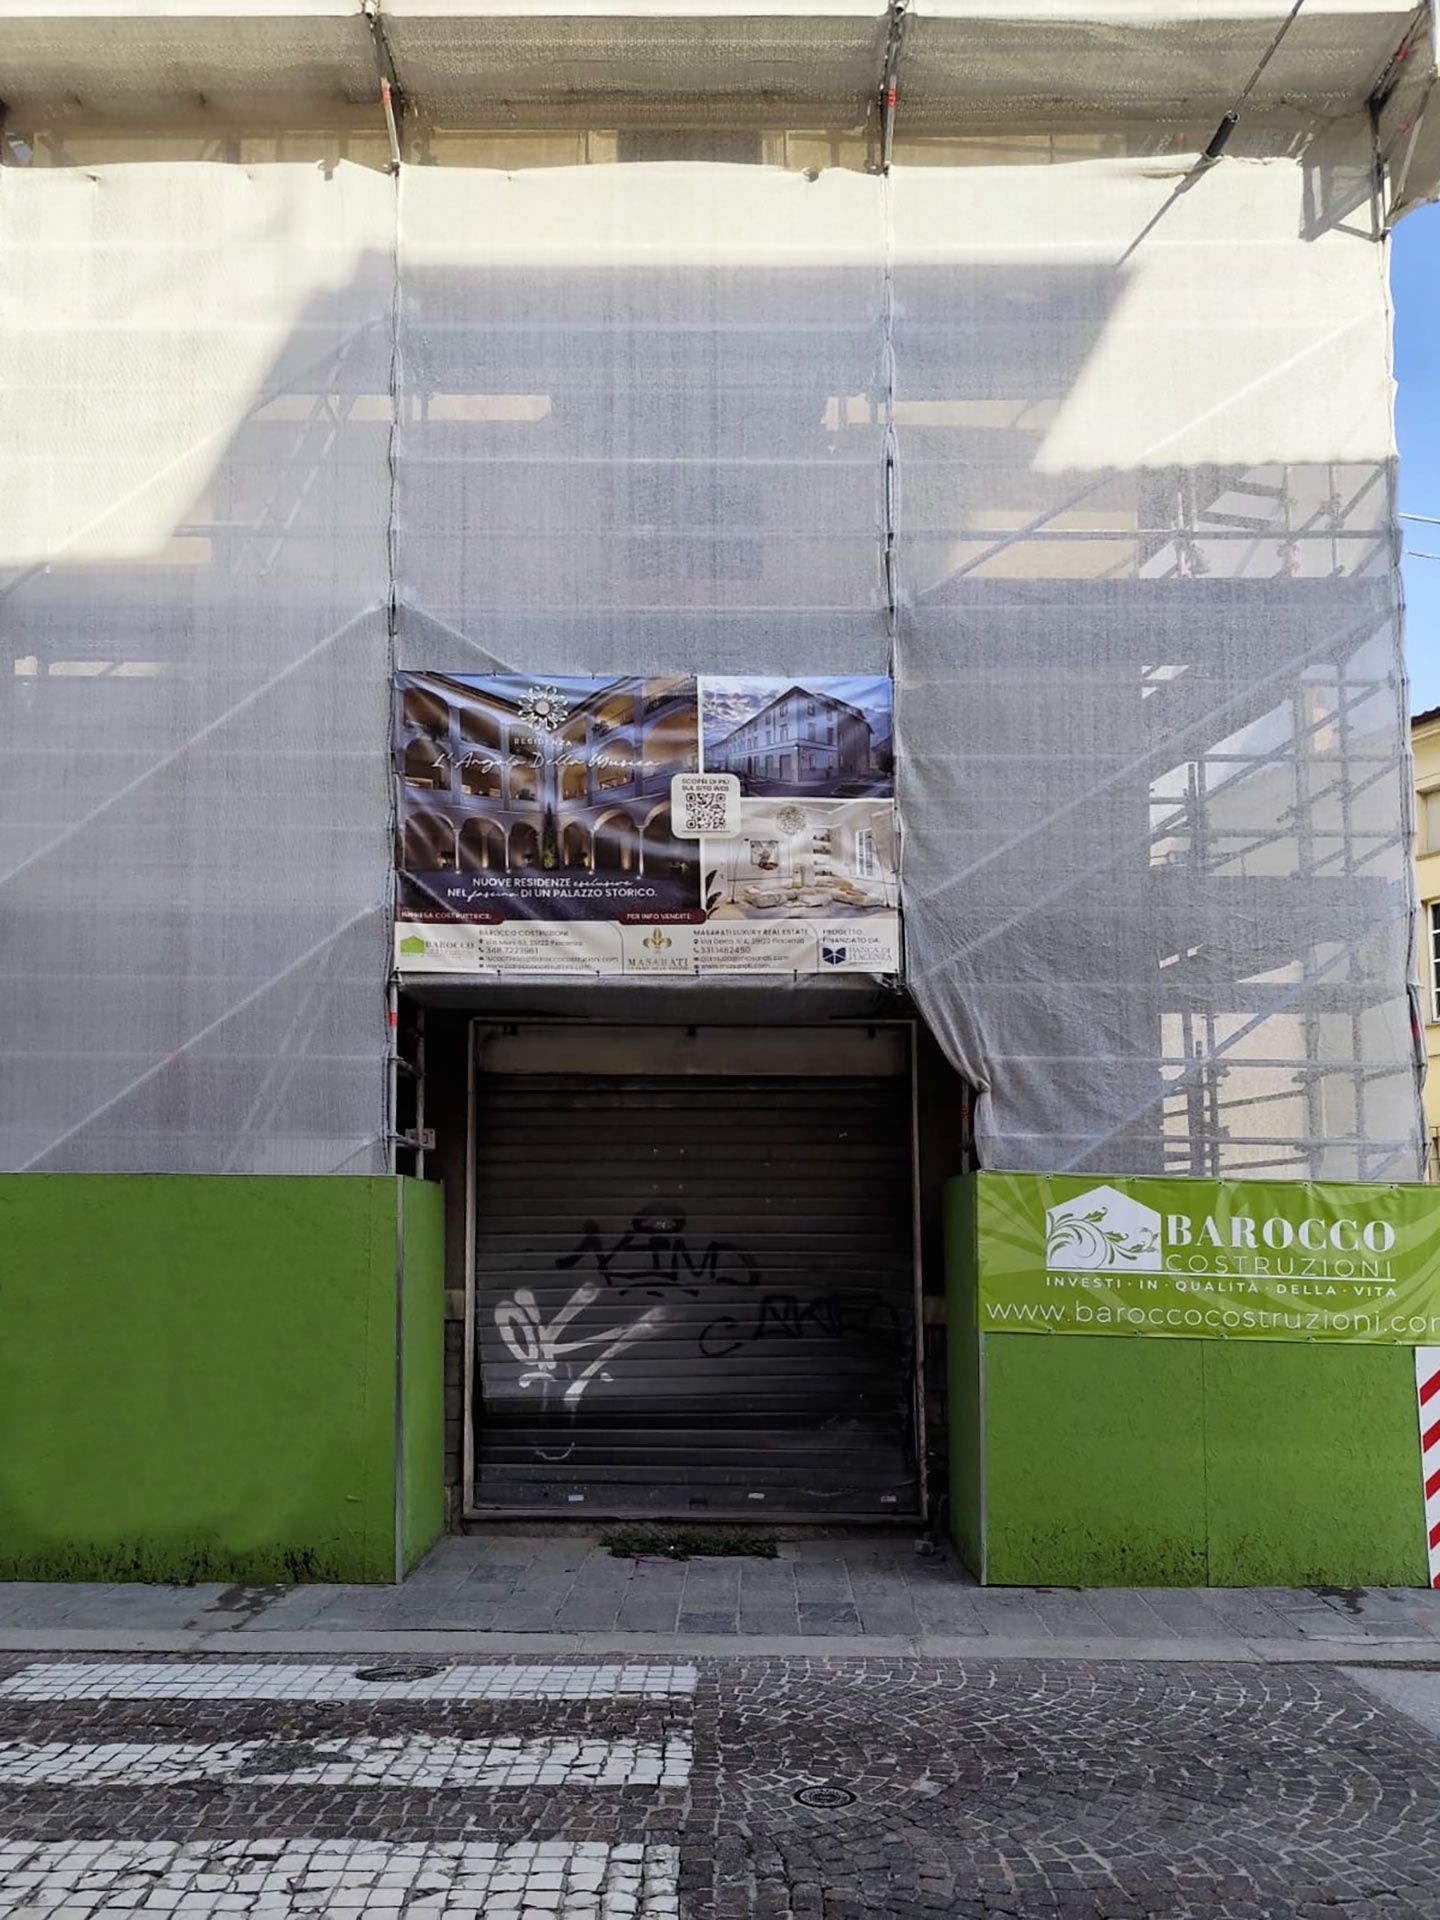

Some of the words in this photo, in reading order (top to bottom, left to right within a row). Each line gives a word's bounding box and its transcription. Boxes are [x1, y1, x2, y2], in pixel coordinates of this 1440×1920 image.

[447, 888, 468, 898] NEL
[521, 888, 532, 898] DI
[534, 888, 551, 898] UN
[553, 888, 603, 898] PALAZZO
[473, 877, 512, 888] NUOVE
[513, 877, 572, 888] RESIDENZE
[1166, 1213, 1396, 1253] BAROCCO
[1165, 1253, 1393, 1279] COSTRUZIONI
[1045, 1275, 1121, 1289] INVESTI
[1139, 1278, 1158, 1291] IN
[1276, 1283, 1337, 1297] DELLA
[1355, 1285, 1398, 1298] VITA
